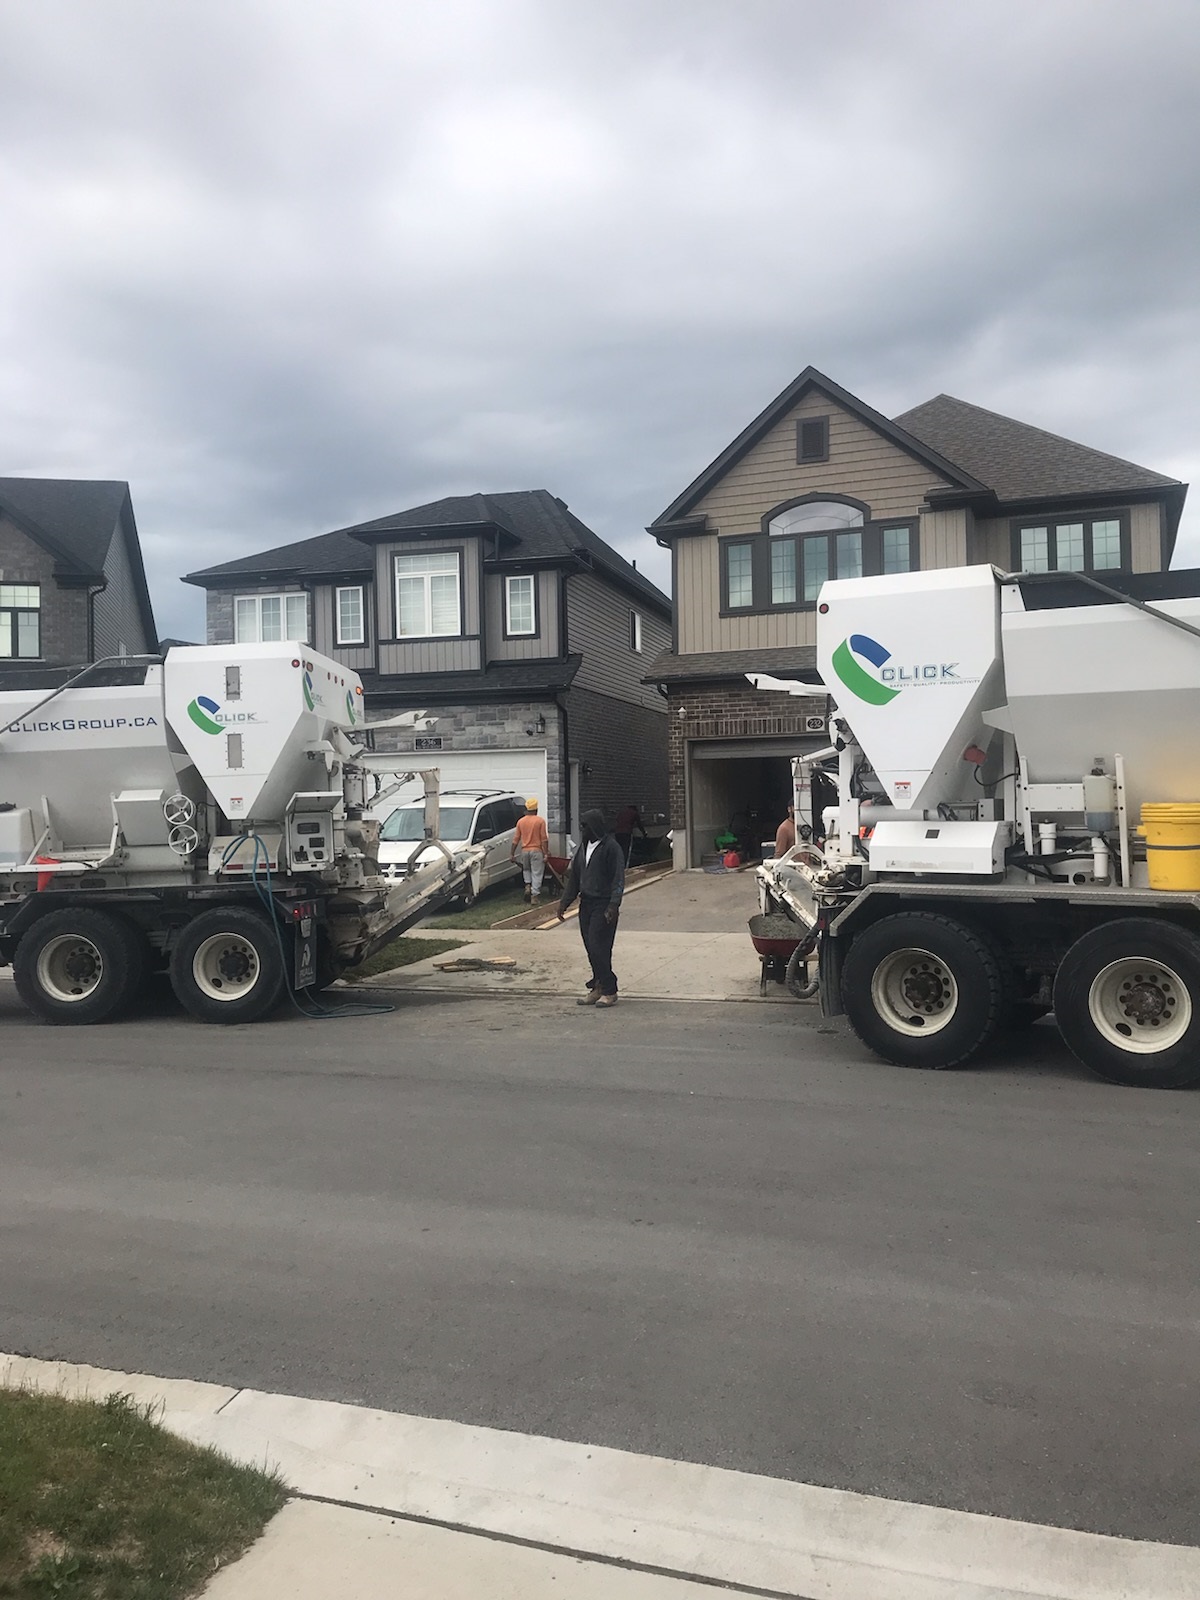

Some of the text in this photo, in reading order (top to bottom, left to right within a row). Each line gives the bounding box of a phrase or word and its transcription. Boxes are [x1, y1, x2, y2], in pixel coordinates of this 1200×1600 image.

[881, 662, 960, 681] CLICK
[215, 712, 258, 722] CLICK
[809, 719, 822, 728] 232
